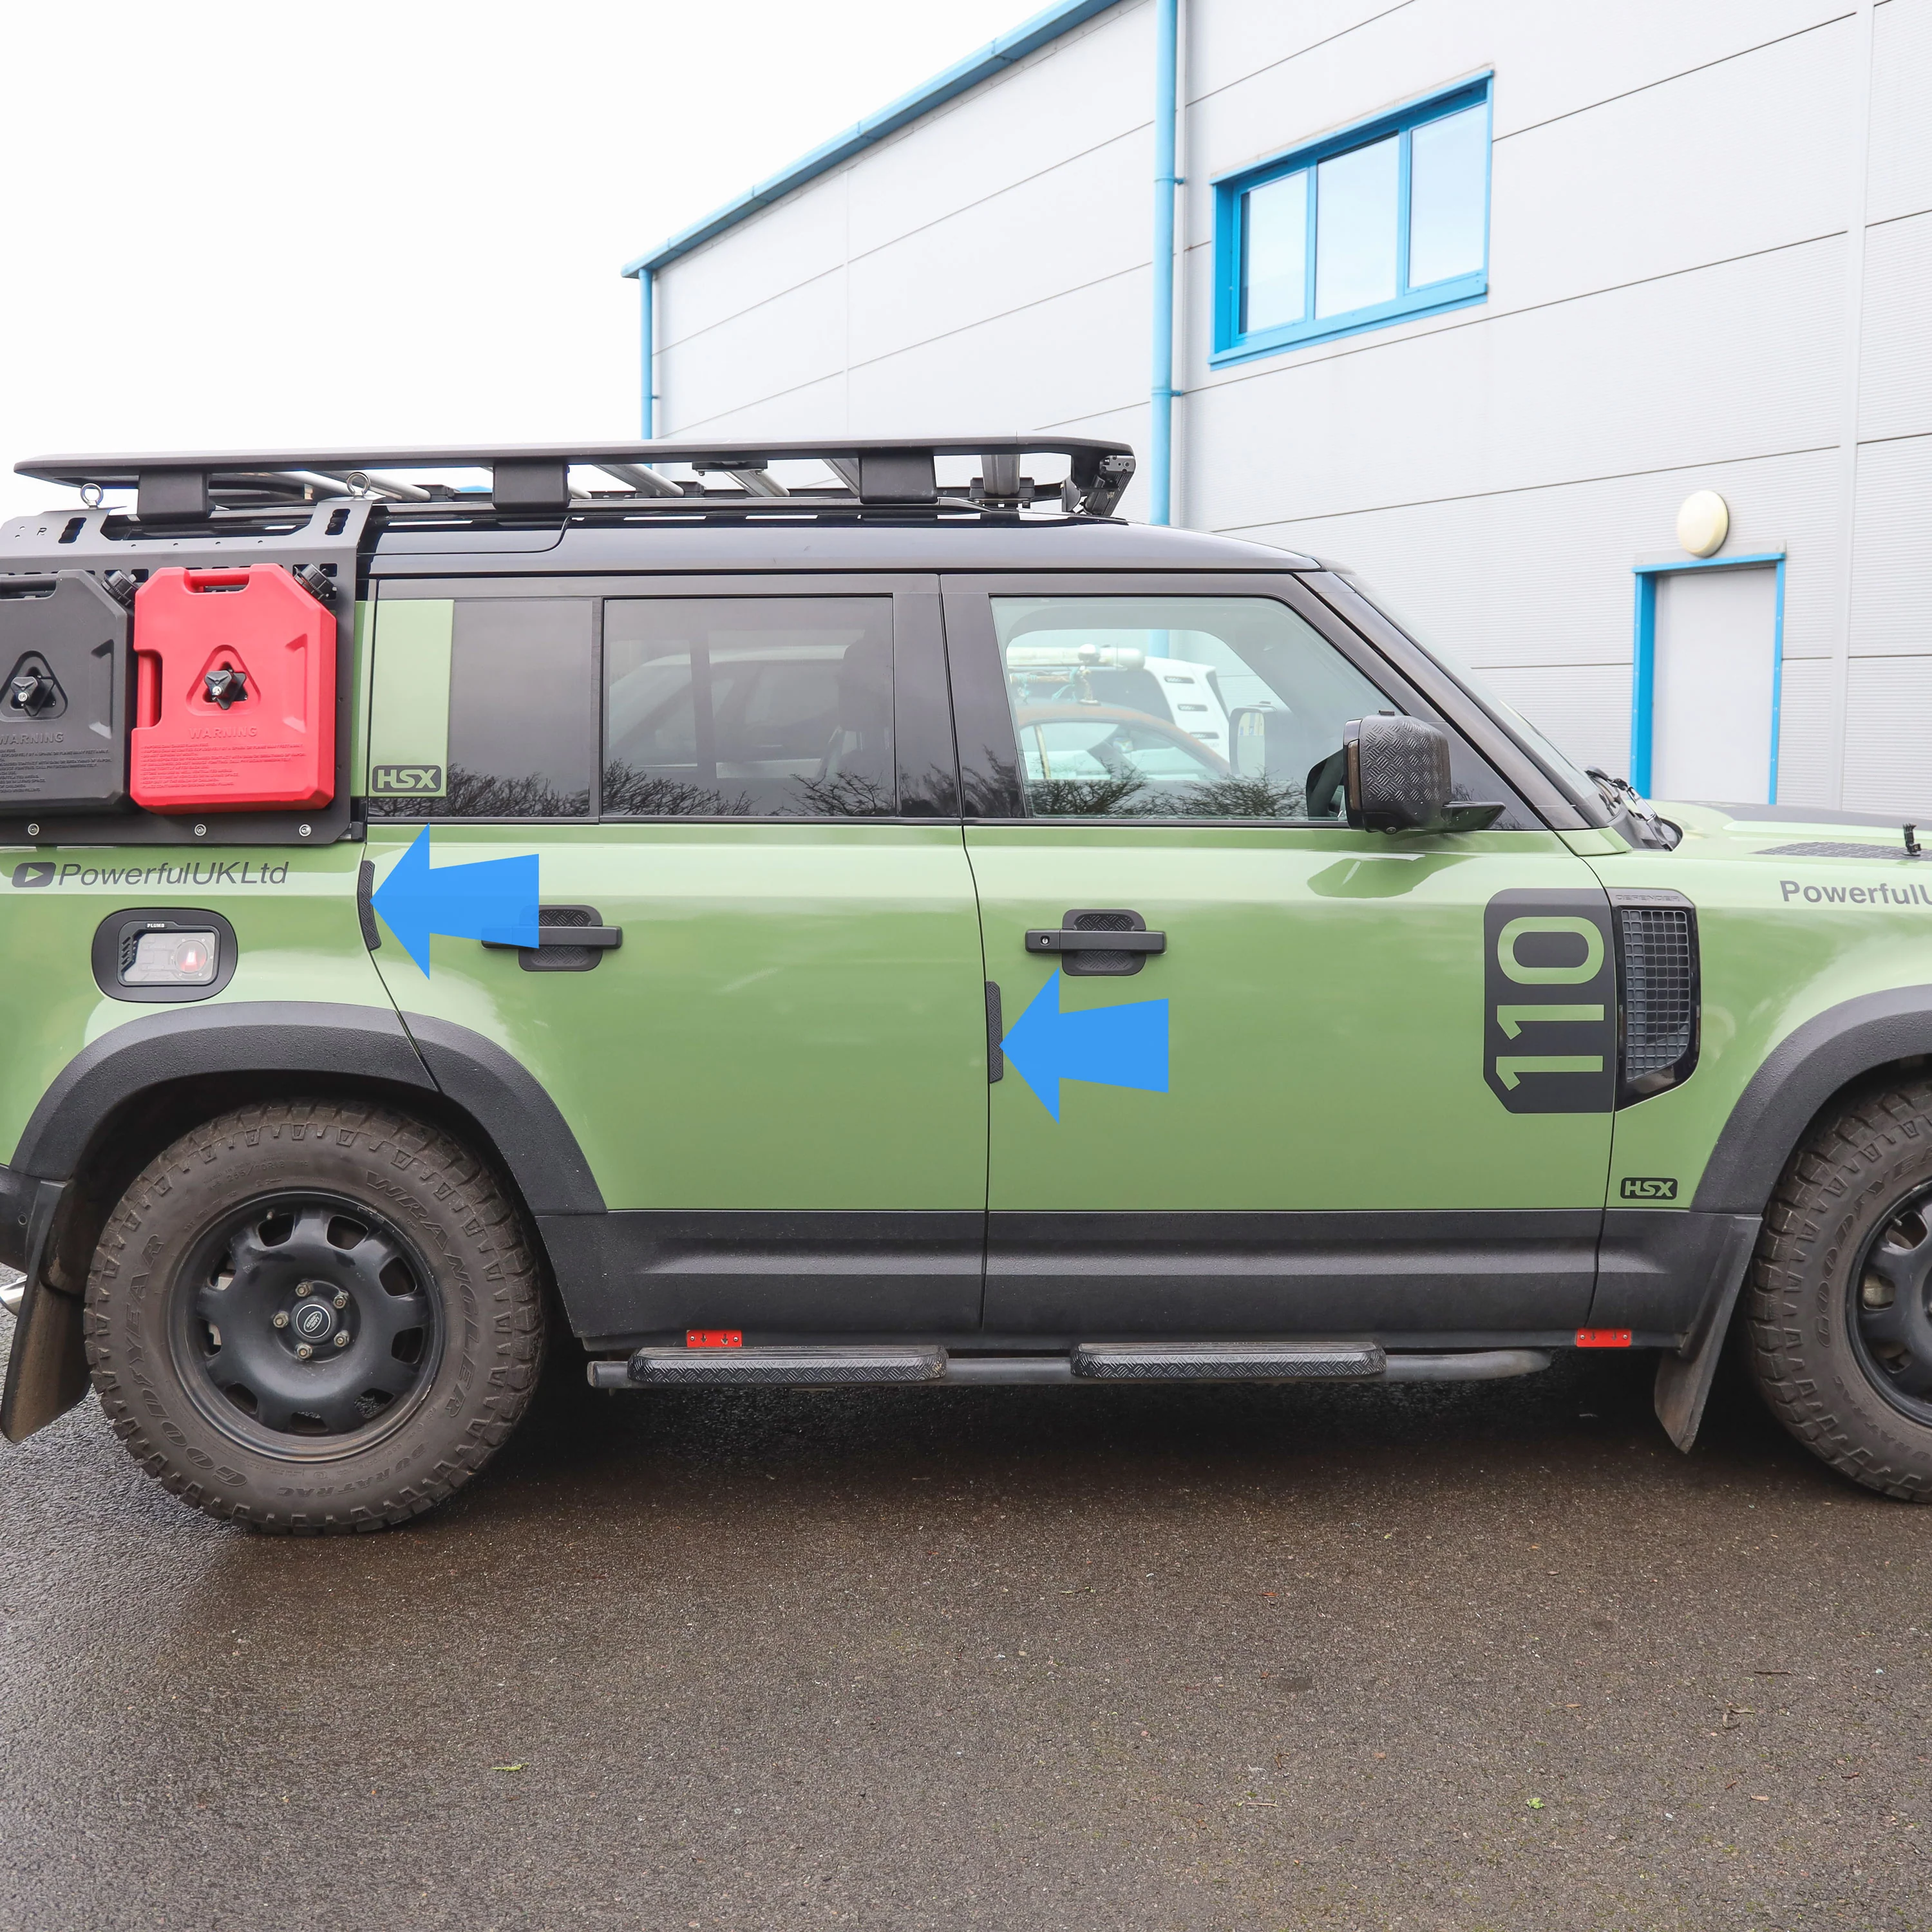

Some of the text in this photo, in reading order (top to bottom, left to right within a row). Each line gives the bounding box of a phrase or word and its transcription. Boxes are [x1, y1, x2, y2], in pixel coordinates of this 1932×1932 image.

[189, 726, 258, 739] WARNING
[377, 769, 437, 789] HSX
[59, 861, 289, 886] PowerfulUKLtd
[1615, 894, 1680, 902] DEFENDER
[1495, 916, 1605, 1092] 110
[1624, 1180, 1674, 1197] HSX
[366, 1170, 480, 1417] WRANGLER
[126, 1233, 248, 1486] GOODYEAR
[276, 1442, 426, 1498] DURATRAC
